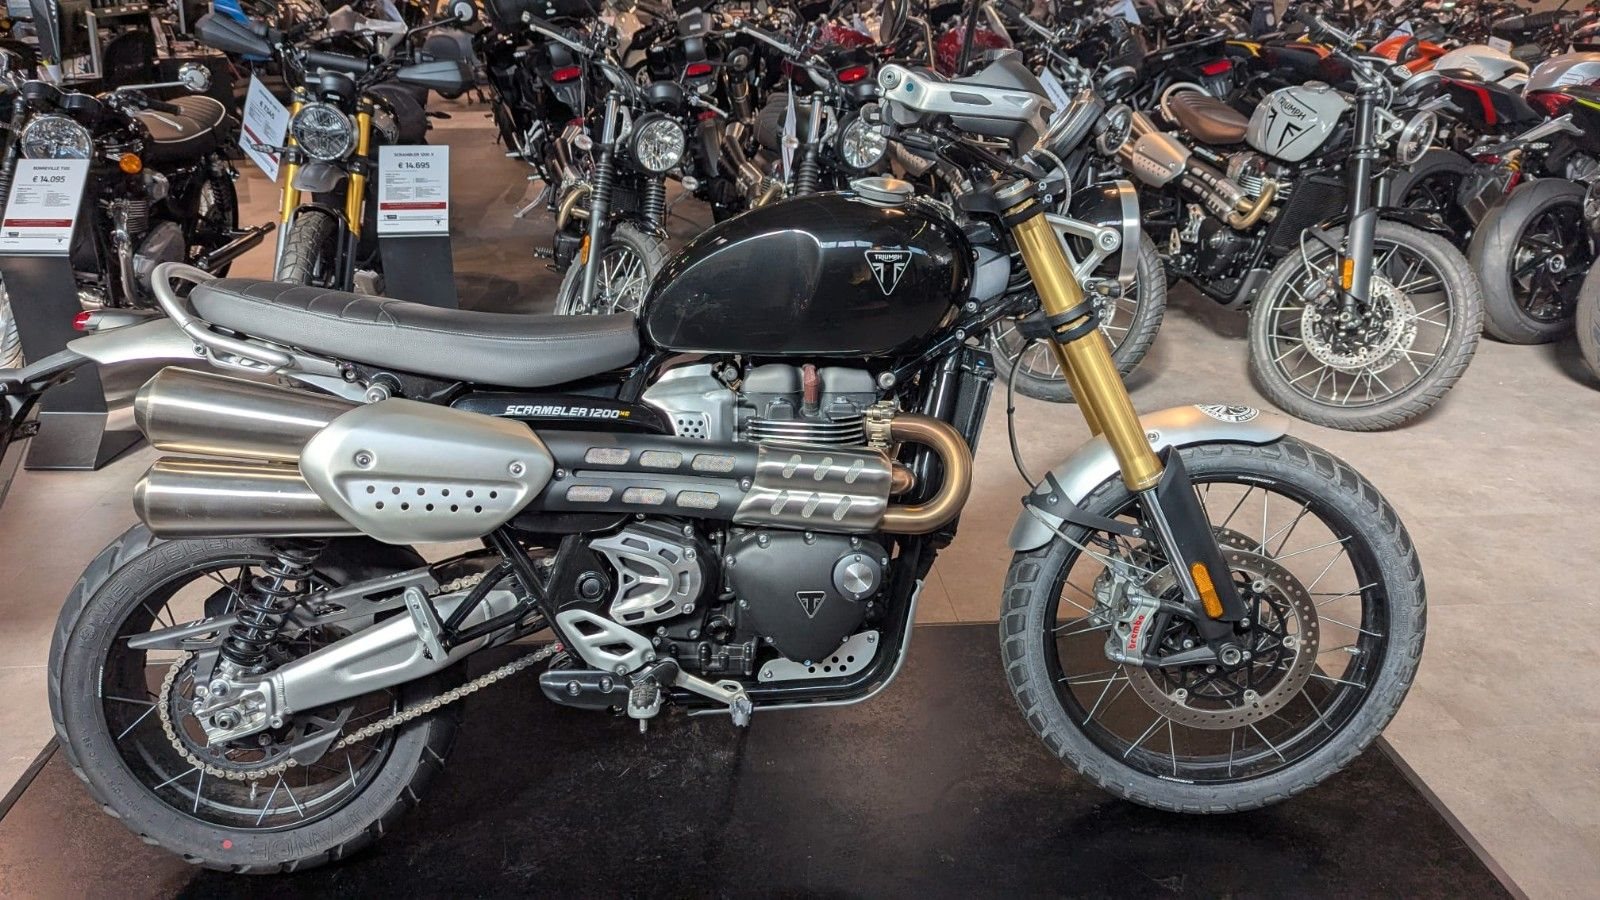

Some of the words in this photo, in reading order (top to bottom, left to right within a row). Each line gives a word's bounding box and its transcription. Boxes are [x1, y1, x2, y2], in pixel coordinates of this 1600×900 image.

[1278, 96, 1306, 121] TRIUMPH
[405, 161, 430, 169] 14.695
[32, 175, 39, 183] €
[40, 175, 66, 183] 14.095
[874, 253, 903, 261] TRIUMPH
[505, 405, 588, 417] SCRAMBLER
[589, 407, 620, 419] 1200
[1127, 615, 1145, 650] brembo
